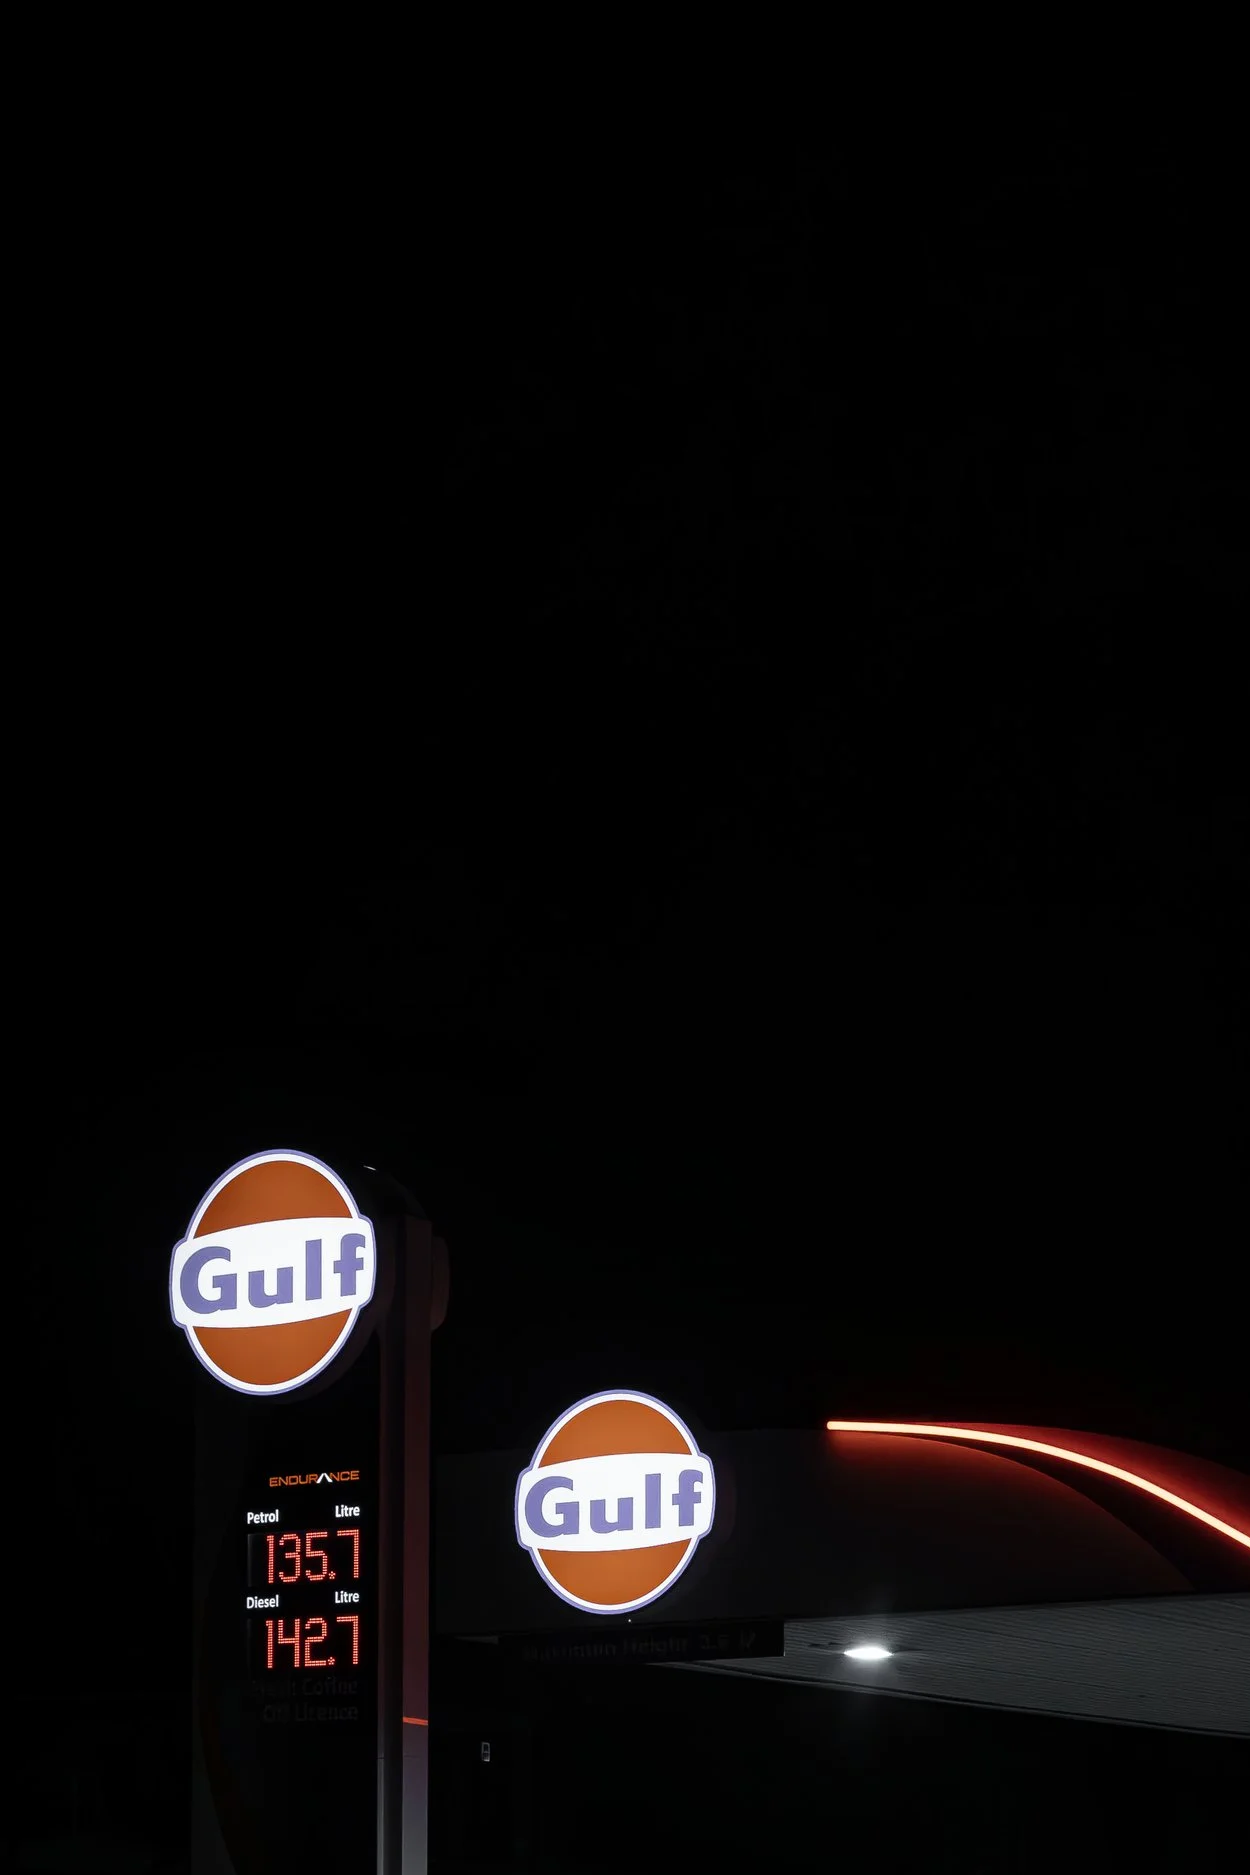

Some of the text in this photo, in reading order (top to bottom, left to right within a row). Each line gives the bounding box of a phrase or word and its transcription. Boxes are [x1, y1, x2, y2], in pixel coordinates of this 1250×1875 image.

[180, 1233, 365, 1314] Gulf
[268, 1470, 361, 1488] ENDURANCE
[525, 1469, 704, 1538] Gulf
[246, 1503, 361, 1525] Petrol Litre
[266, 1528, 360, 1584] 135.7
[246, 1590, 360, 1610] Diesel Litre
[265, 1615, 359, 1669] 142.7
